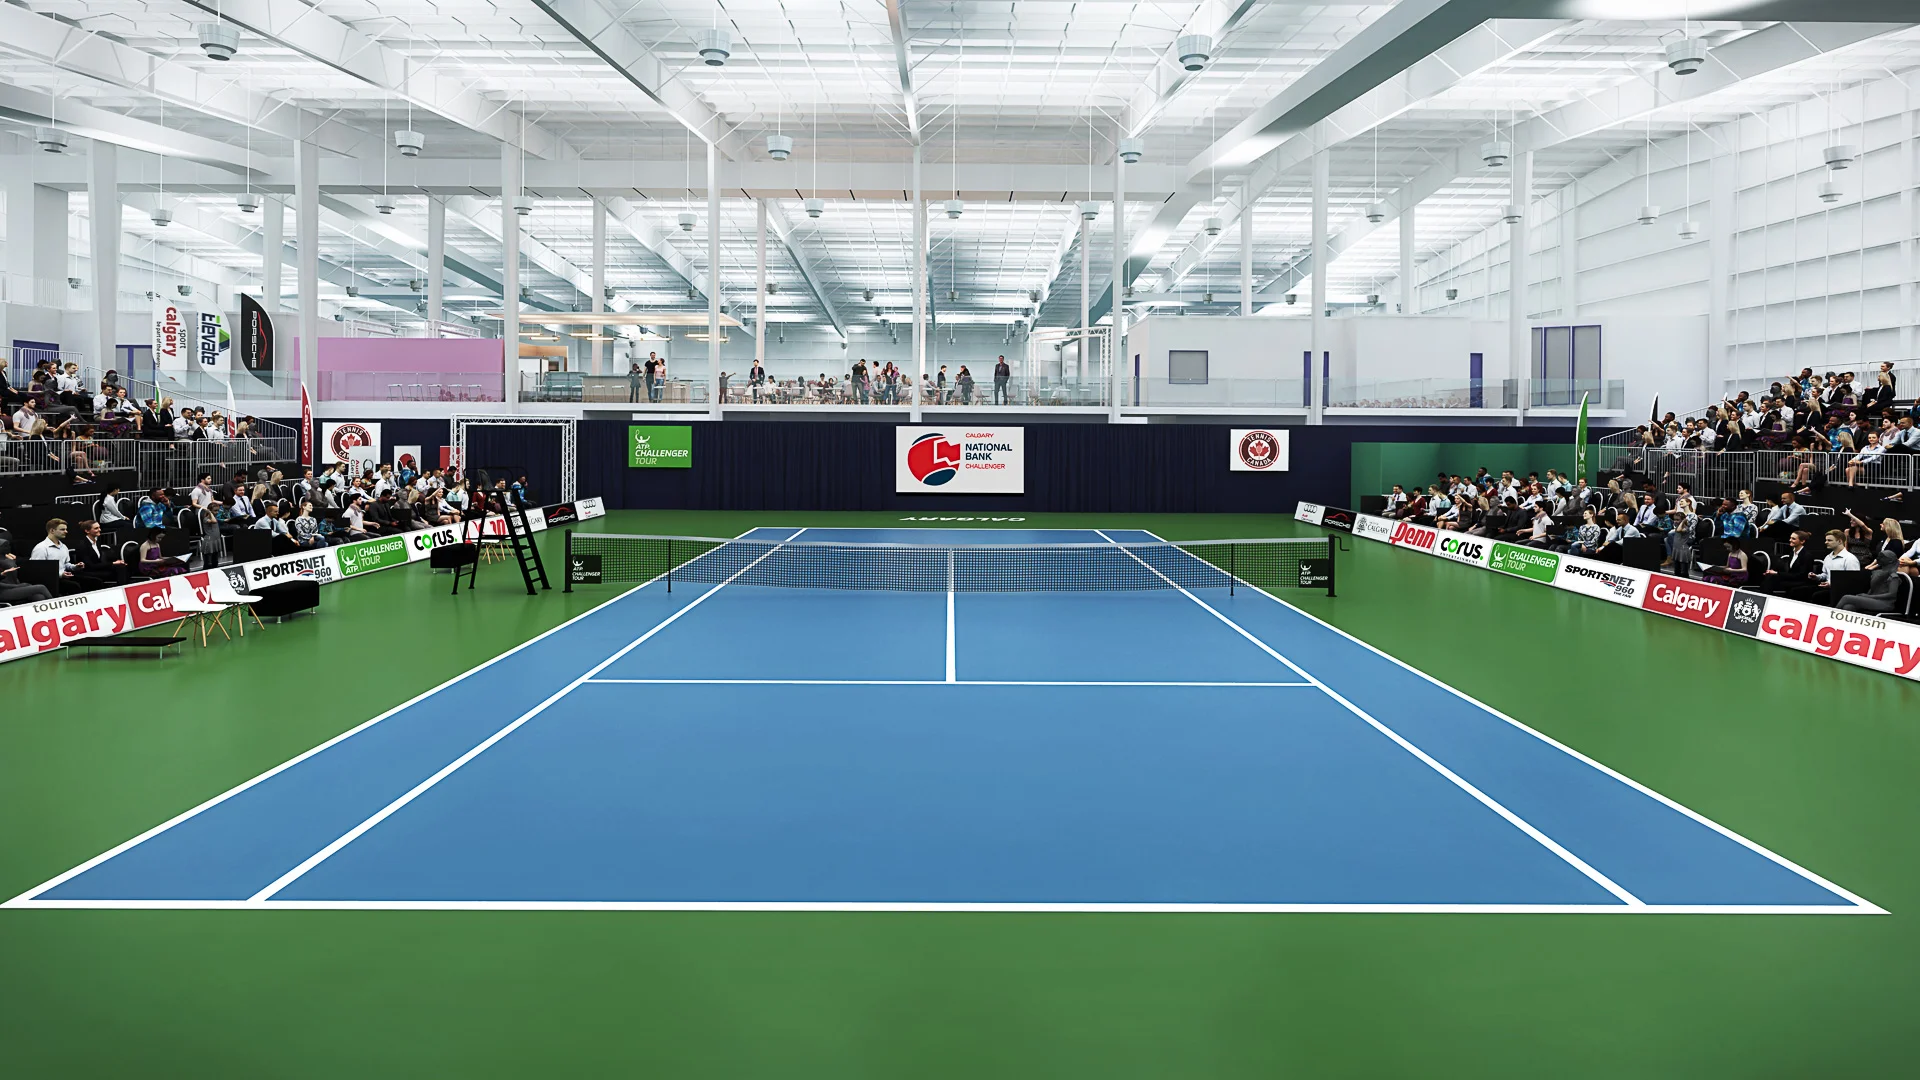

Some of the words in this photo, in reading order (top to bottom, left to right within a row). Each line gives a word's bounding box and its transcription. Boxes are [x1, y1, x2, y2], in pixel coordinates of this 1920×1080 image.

[162, 306, 180, 357] calgary
[201, 313, 221, 366] Elevate
[339, 426, 364, 435] TENNIS
[1246, 432, 1272, 442] TENNIS
[965, 443, 1012, 452] NATIONAL
[1246, 458, 1272, 466] CANADA
[548, 514, 575, 524] PORSCHE
[1324, 519, 1351, 529] PORSCHE
[1367, 525, 1389, 534] CALGARY
[359, 540, 403, 557] CHALLENGER
[361, 555, 381, 567] TOUR
[1507, 560, 1526, 571] TOUR
[1509, 550, 1556, 568] CHALLENGER
[253, 555, 326, 582] SPORTSNET
[314, 567, 332, 579] 960
[1565, 564, 1635, 587] SPORTSNET
[1615, 585, 1634, 595] 960
[33, 596, 88, 613] tourism
[137, 585, 210, 613] Calry
[1652, 584, 1720, 618] Calgary
[1829, 609, 1886, 630] tourism
[1761, 614, 1920, 675] calgary
